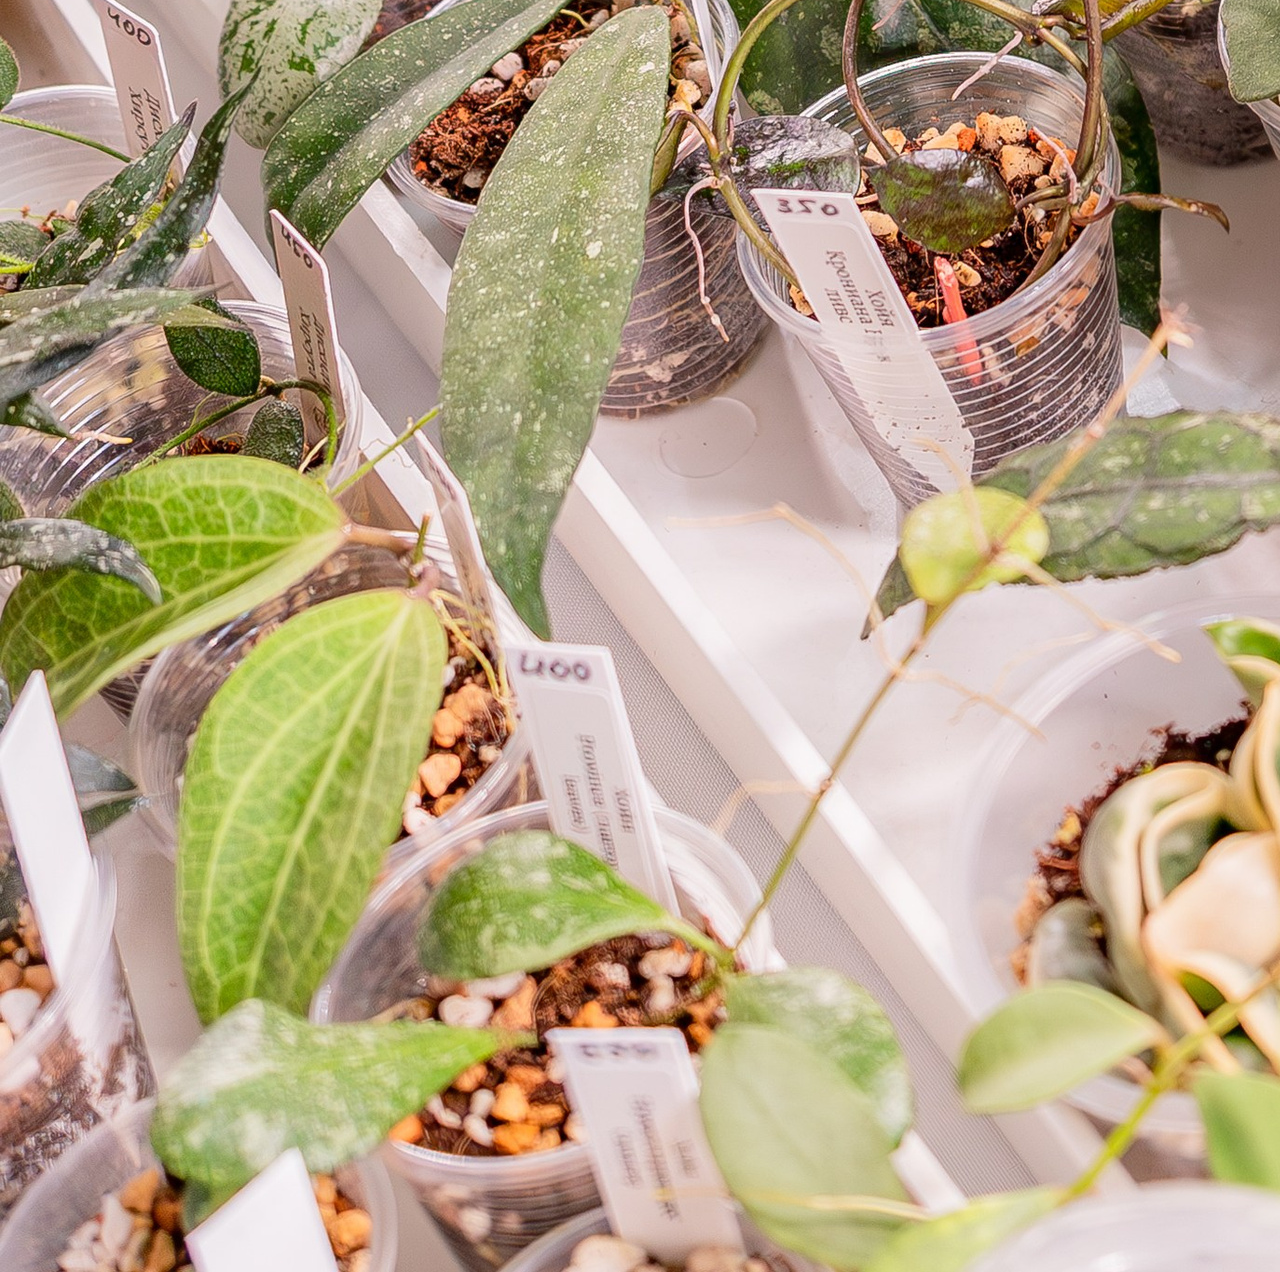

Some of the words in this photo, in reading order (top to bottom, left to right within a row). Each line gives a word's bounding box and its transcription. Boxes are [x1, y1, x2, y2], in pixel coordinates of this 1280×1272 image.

[776, 198, 840, 216] 350
[824, 286, 854, 324] ливс
[825, 249, 873, 325] Крониана
[864, 289, 895, 327] Хойя
[520, 652, 592, 681] 400
